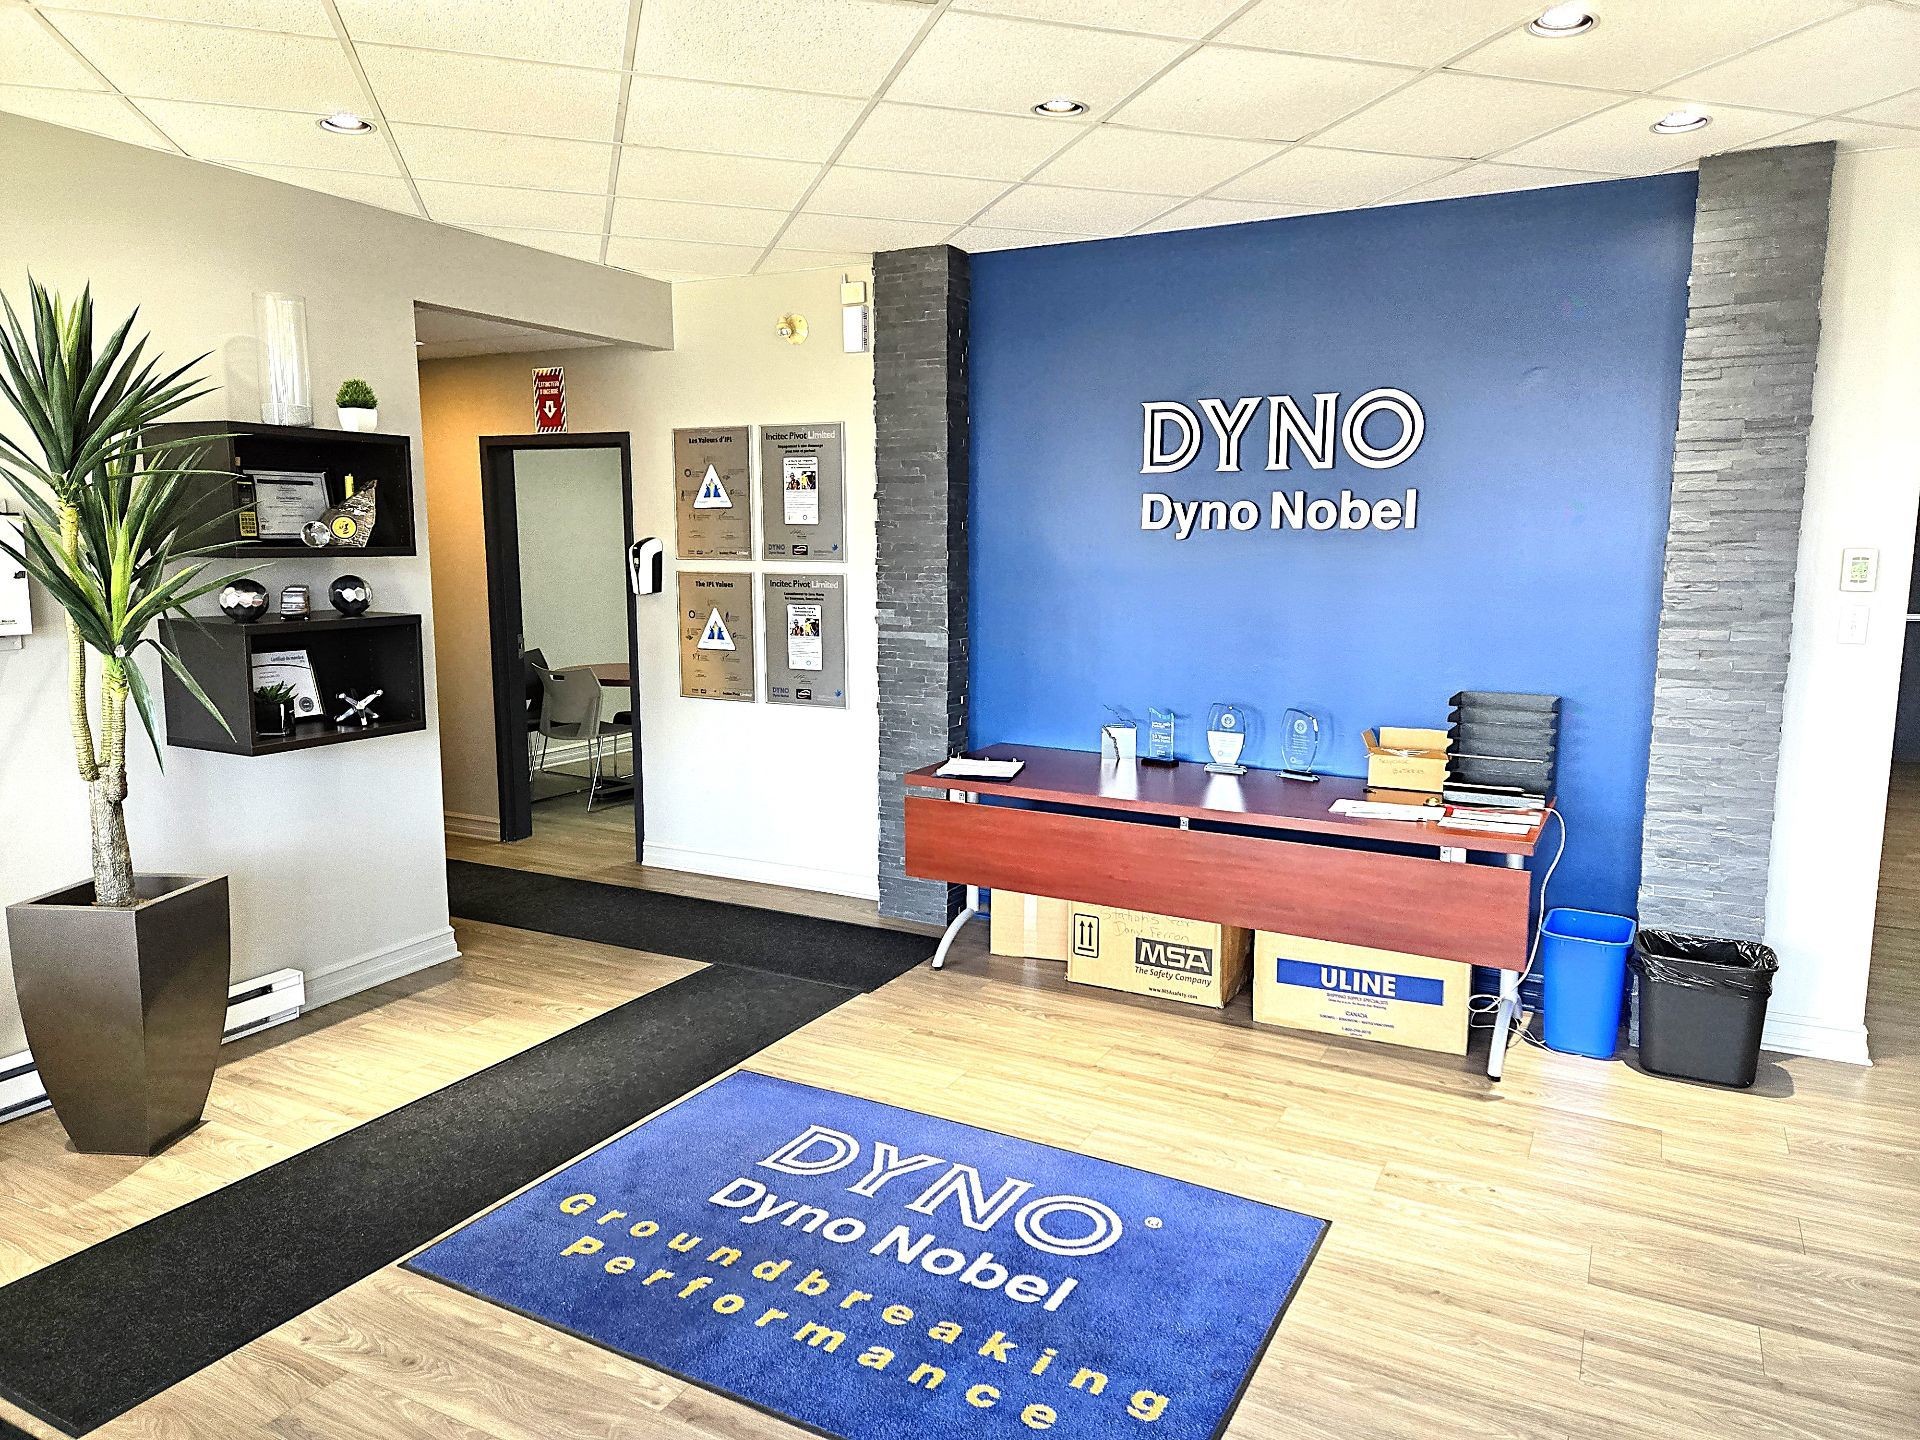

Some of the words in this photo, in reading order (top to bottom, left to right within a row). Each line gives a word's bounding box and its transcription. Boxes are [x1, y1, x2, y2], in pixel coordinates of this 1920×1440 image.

[718, 435, 733, 443] d'IPL
[765, 432, 788, 441] Incitec
[789, 431, 807, 440] Pivot
[807, 429, 836, 440] Limited
[1139, 387, 1425, 474] DYNO
[1140, 492, 1259, 540] Dyno
[1270, 488, 1418, 530] Nobel
[768, 543, 786, 551] DYNO
[695, 580, 706, 588] The
[769, 579, 792, 588] Incitec
[793, 579, 811, 588] Pivot
[811, 580, 839, 589] Limited
[772, 686, 790, 694] DYNO
[1139, 941, 1211, 974] MSA
[1135, 965, 1149, 976] The
[1149, 968, 1174, 981] Safety
[1174, 972, 1212, 988] Company
[1320, 966, 1397, 998] ULINE
[1345, 1010, 1369, 1019] CANADA
[756, 1124, 1123, 1257] DYNO
[708, 1176, 866, 1244] Dyno
[870, 1224, 1079, 1313] Nobel
[559, 1191, 1170, 1423] Groundbreaking
[560, 1236, 1058, 1430] Performance
